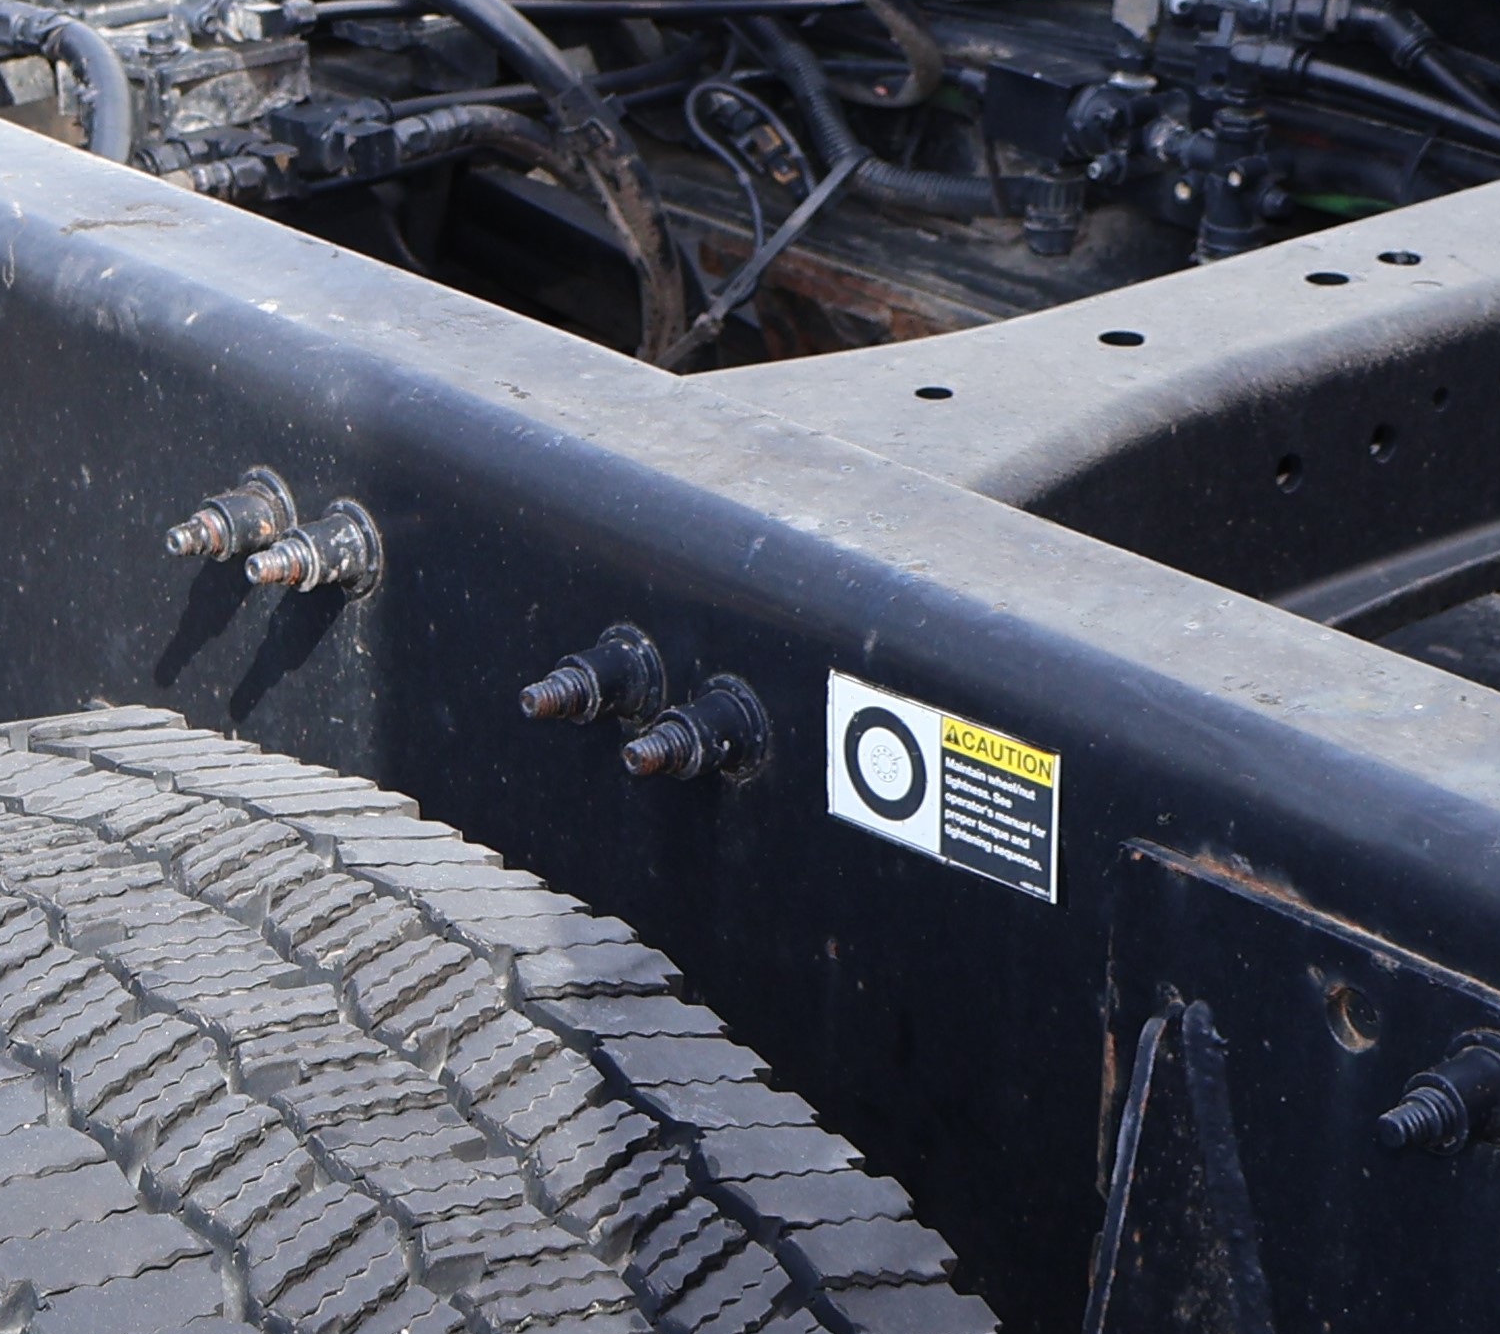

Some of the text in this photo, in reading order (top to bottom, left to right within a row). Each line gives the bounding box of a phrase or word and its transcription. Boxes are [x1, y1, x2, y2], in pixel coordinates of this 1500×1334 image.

[945, 757, 986, 781] Maintain
[961, 730, 1052, 781] CAUTION
[993, 792, 1013, 809] See
[945, 809, 1030, 849] proper torque and
[945, 824, 992, 853] tightening
[995, 811, 1031, 832] manual
[1032, 823, 1046, 839] for
